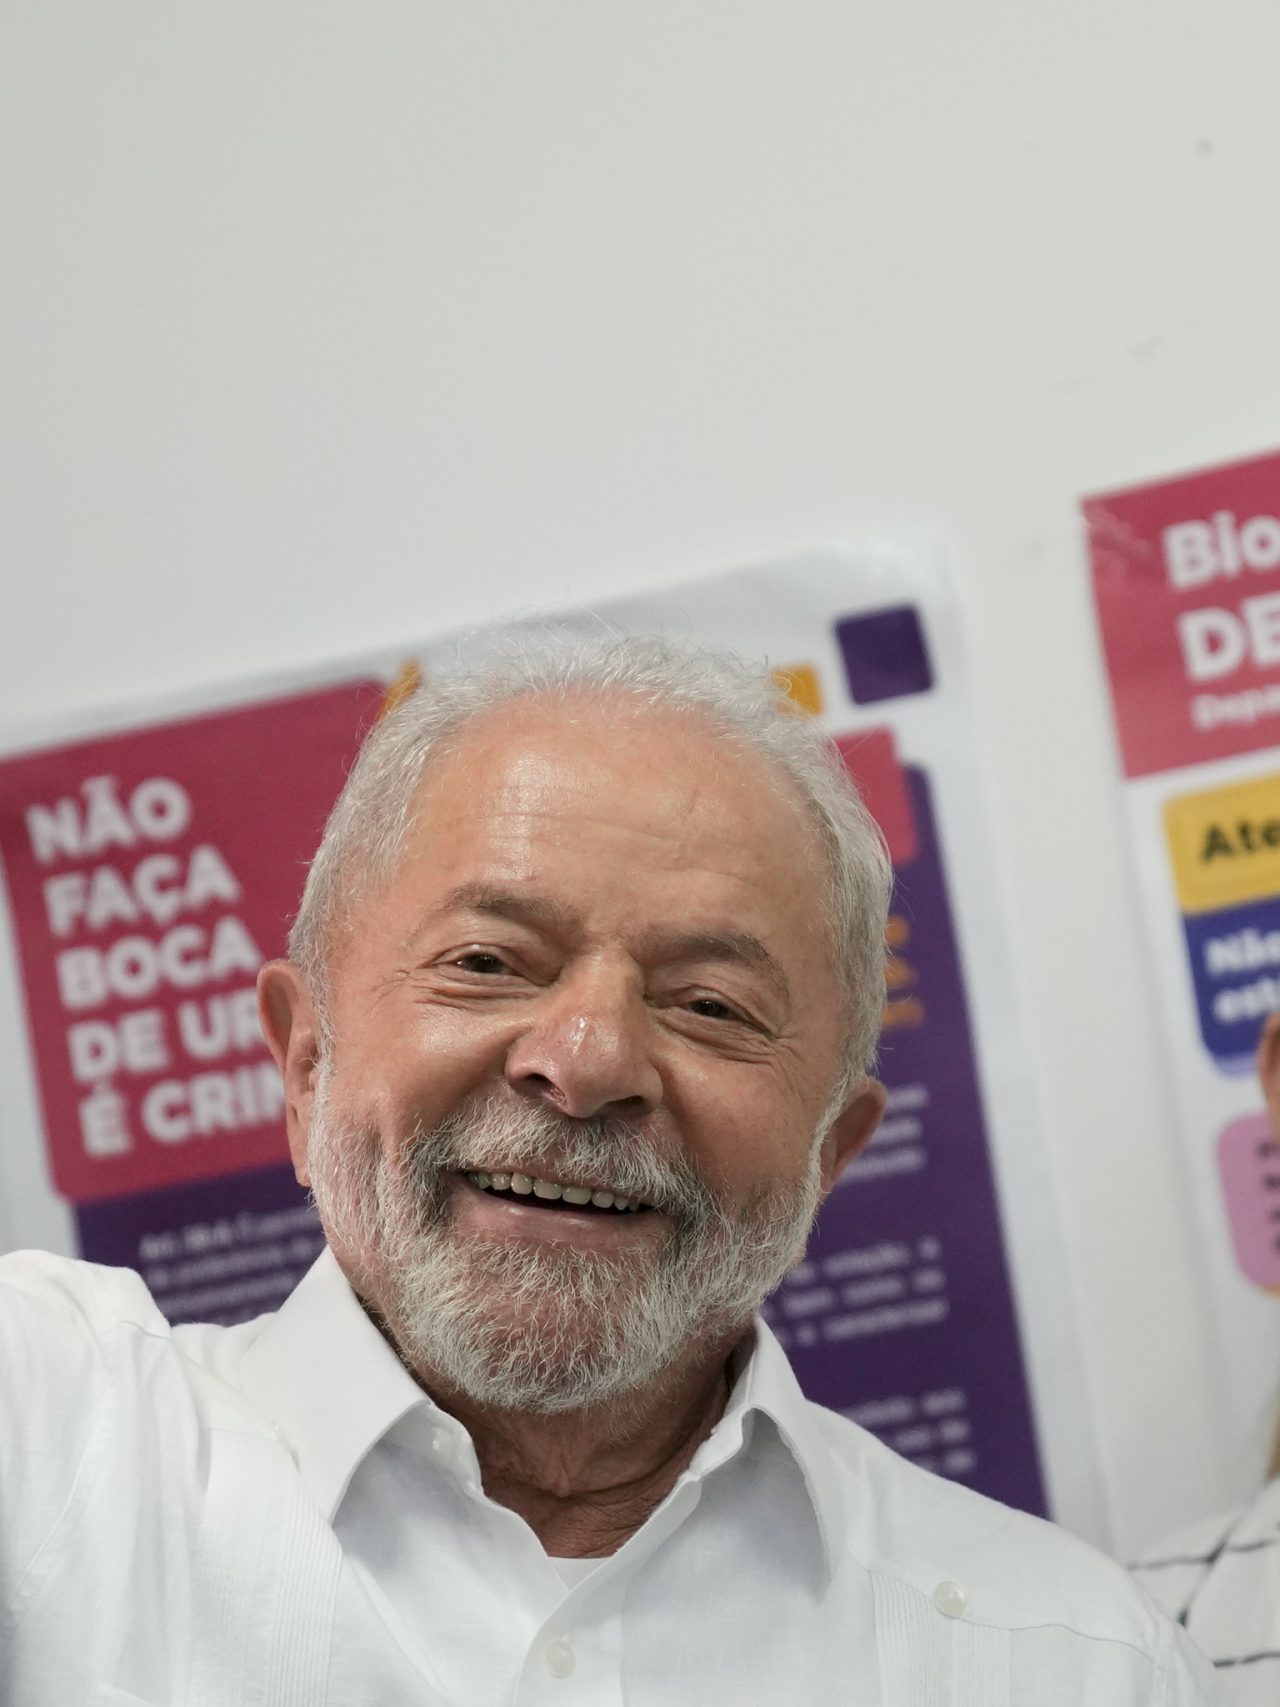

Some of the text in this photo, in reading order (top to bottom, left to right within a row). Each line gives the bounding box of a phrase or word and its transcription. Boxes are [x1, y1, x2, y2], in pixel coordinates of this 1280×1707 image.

[25, 775, 191, 863] NÃO
[44, 845, 240, 936] FAÇA
[57, 916, 263, 1010] BOCA
[67, 1008, 168, 1083] DE
[79, 1079, 132, 1157] É
